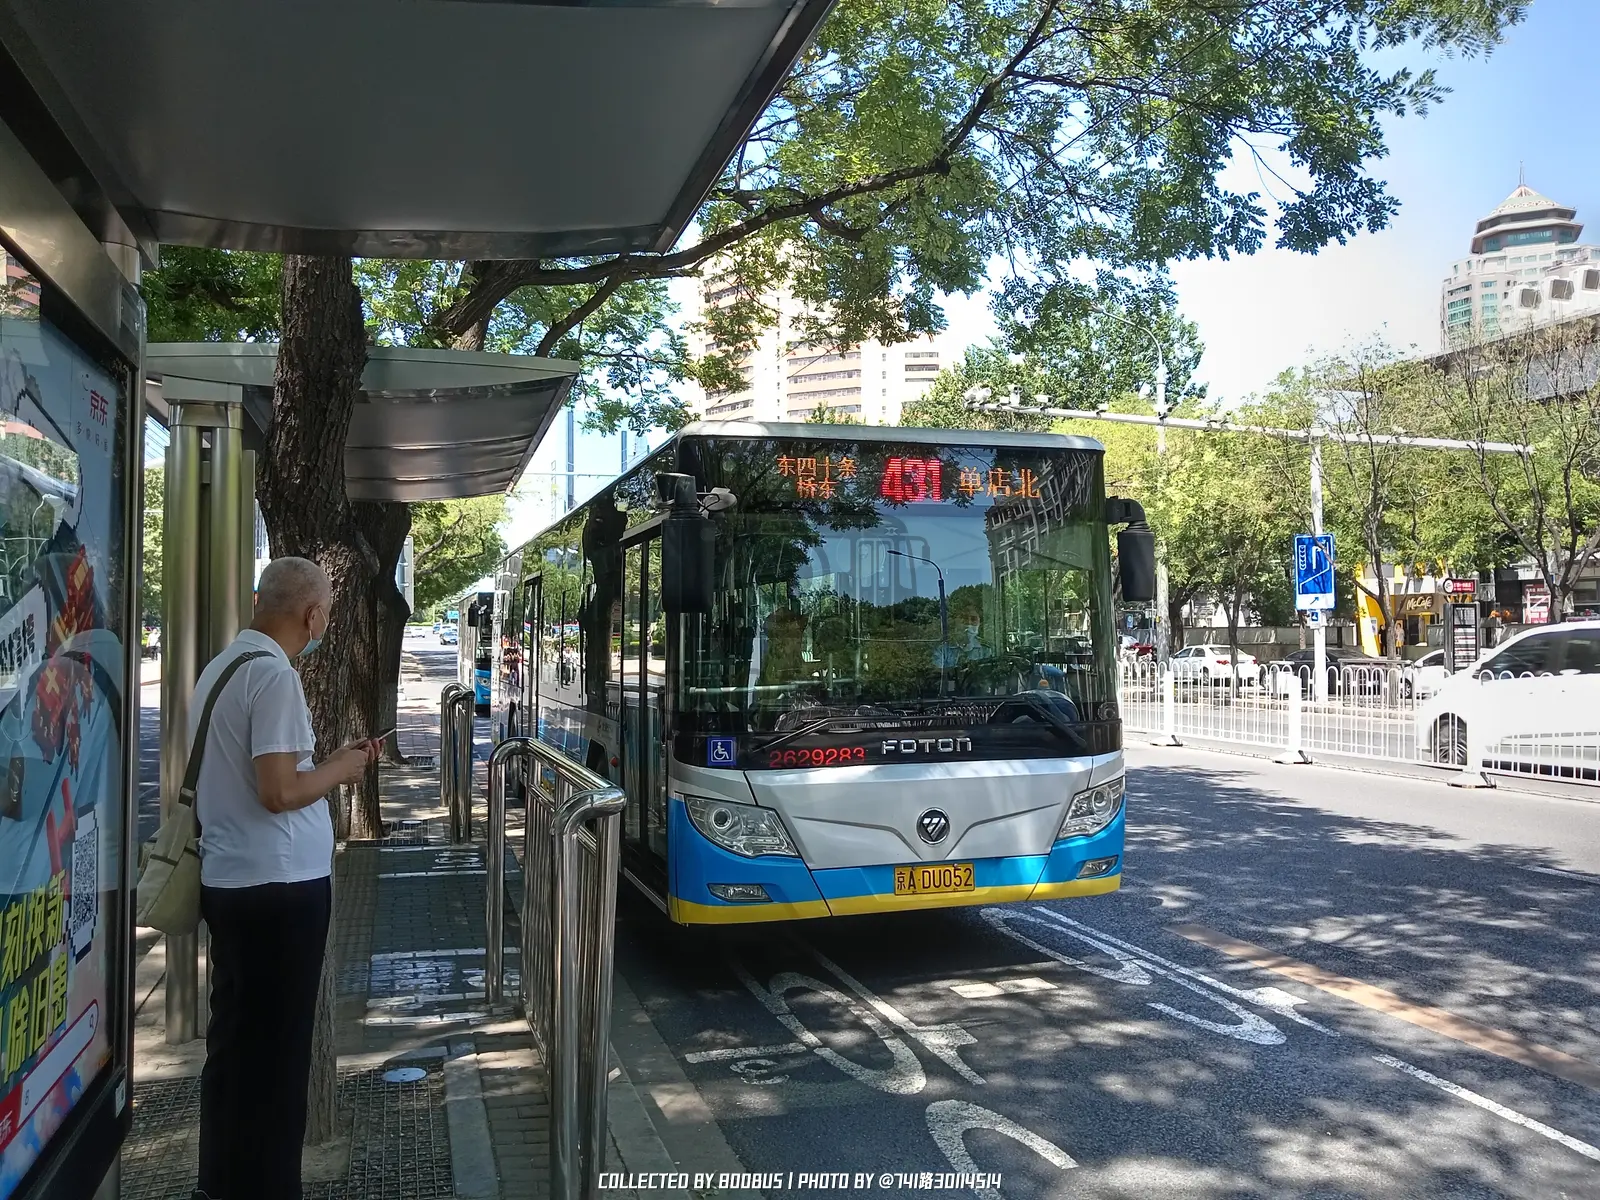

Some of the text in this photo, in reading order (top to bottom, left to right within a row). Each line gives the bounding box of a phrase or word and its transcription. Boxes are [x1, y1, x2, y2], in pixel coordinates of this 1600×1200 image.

[90, 390, 109, 428] 京东
[776, 454, 858, 479] 东四十条
[881, 456, 942, 502] 431
[959, 465, 1040, 499] 单店北
[796, 477, 838, 499] 桥东
[769, 746, 866, 768] 2629283
[881, 736, 972, 755] FOTON
[0, 868, 66, 992] 刻换新
[0, 951, 68, 1085] 除旧患
